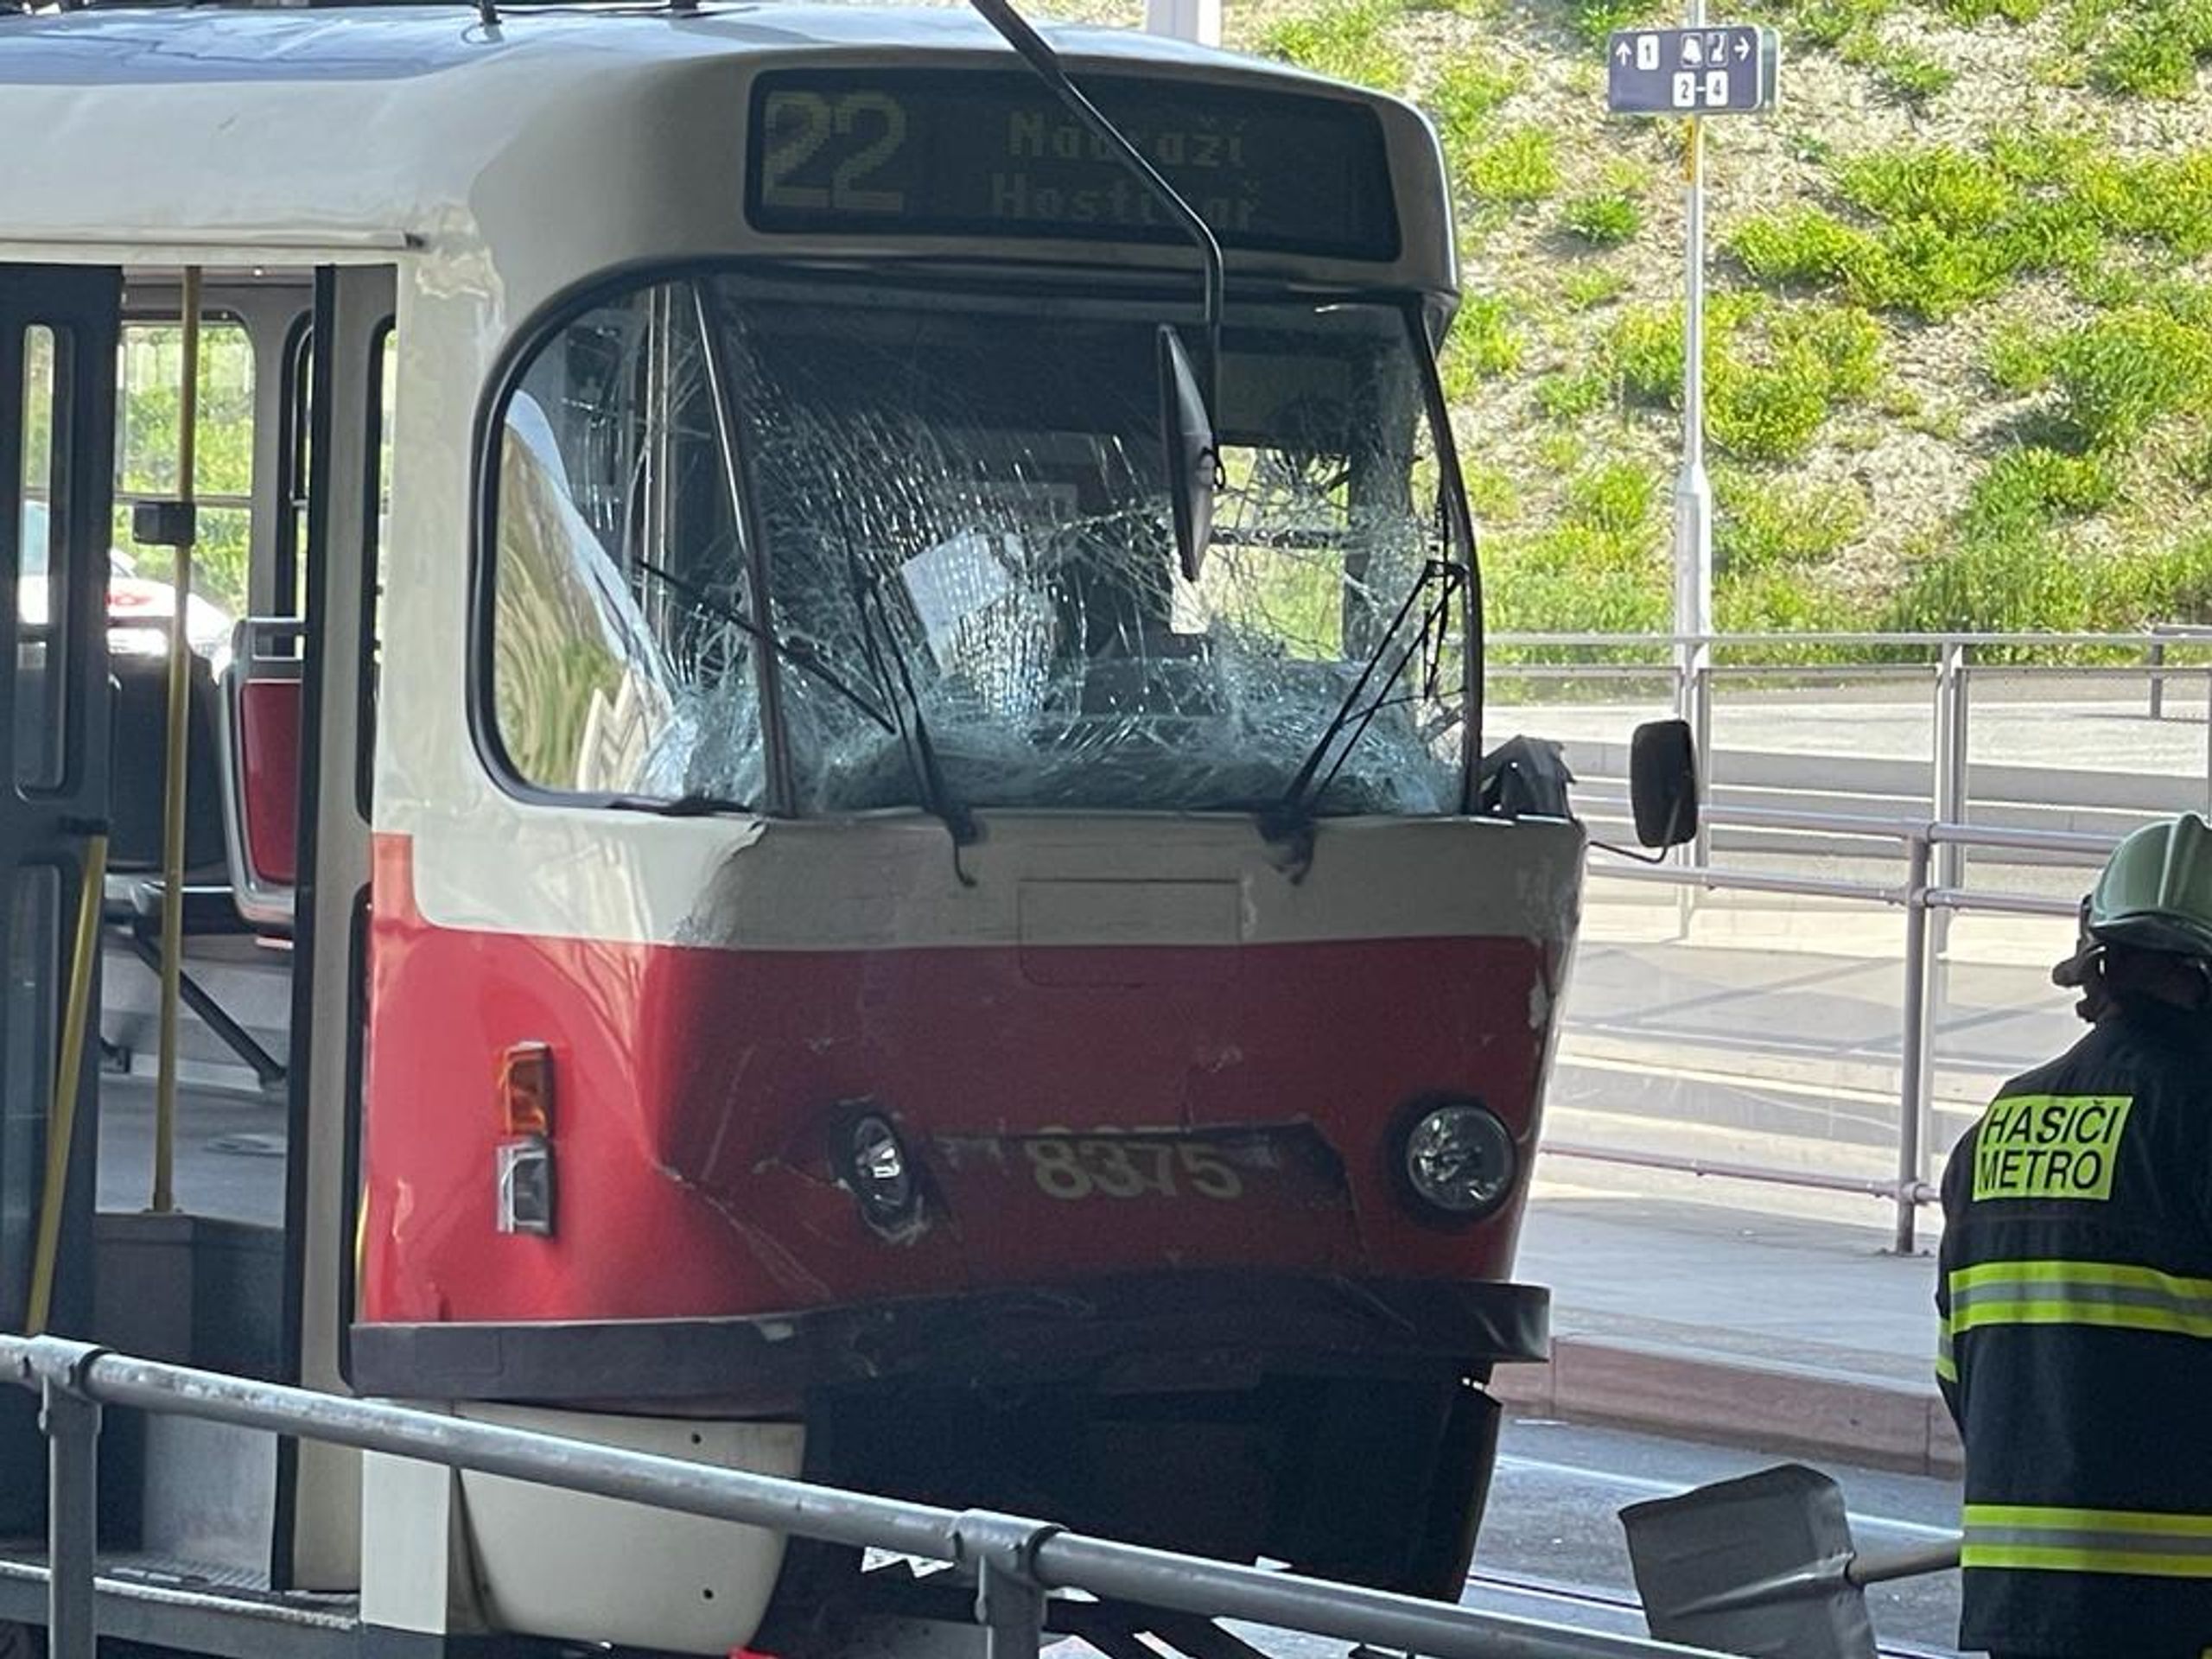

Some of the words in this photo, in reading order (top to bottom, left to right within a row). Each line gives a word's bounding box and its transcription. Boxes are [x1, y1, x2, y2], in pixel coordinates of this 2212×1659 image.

[761, 89, 906, 213] 22
[1007, 110, 1247, 168] Náaží
[990, 172, 1261, 231] Hostiař
[1983, 1099, 2120, 1144] HASIČI
[1023, 1125, 1243, 1199] 8375
[1979, 1149, 2103, 1192] METRO
